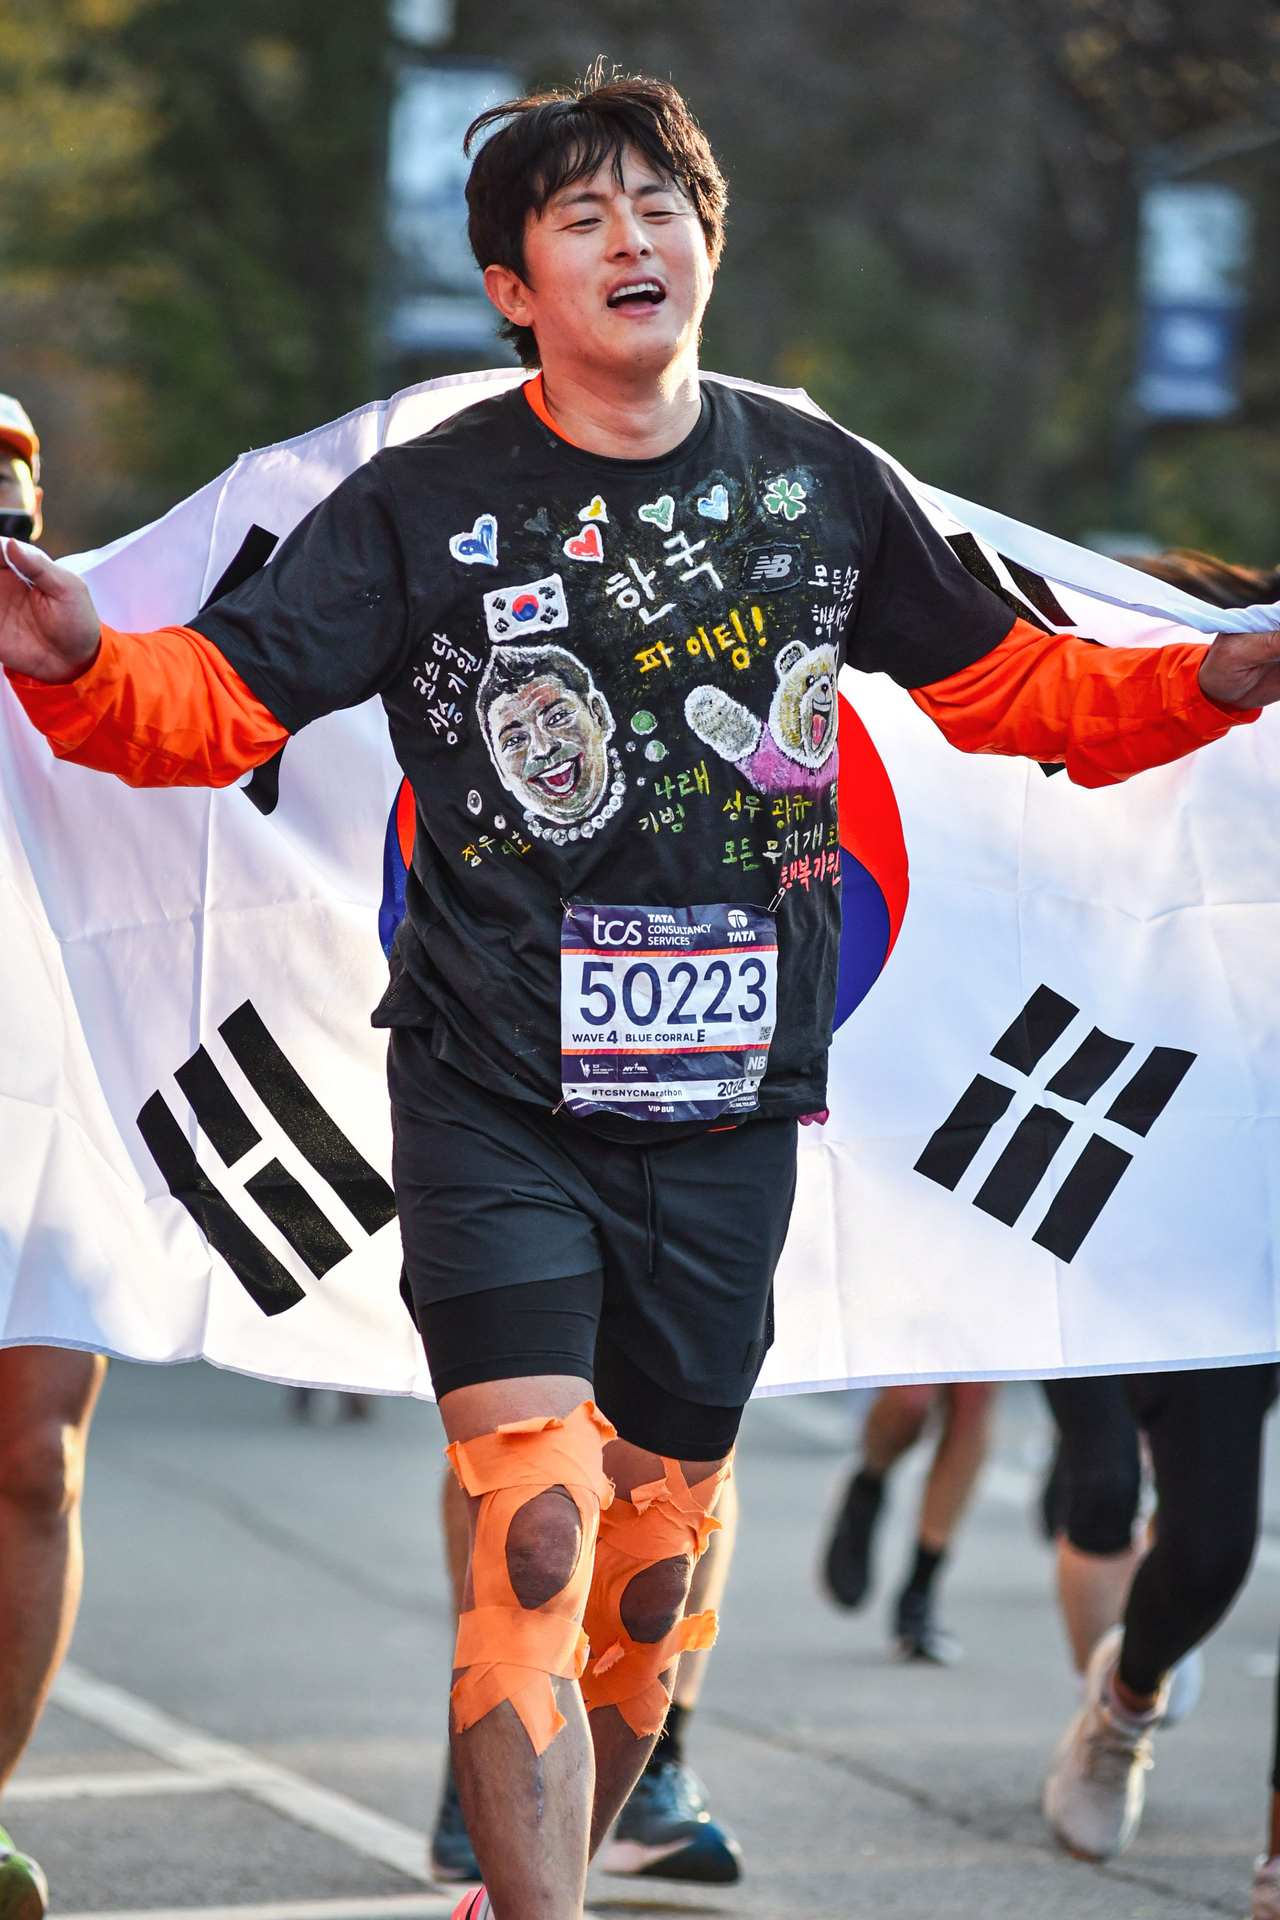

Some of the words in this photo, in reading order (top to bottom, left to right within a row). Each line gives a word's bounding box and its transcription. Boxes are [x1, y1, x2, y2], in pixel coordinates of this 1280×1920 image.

[605, 530, 724, 625] 한국
[750, 553, 793, 580] NB
[634, 606, 767, 673] 파이팅!
[412, 632, 458, 700] 코스닥
[427, 699, 463, 745] 상승
[448, 647, 483, 694] 기원
[654, 759, 710, 800] 나래
[638, 802, 686, 833] 기범
[722, 789, 764, 823] 성우
[772, 794, 814, 829] 광규
[722, 837, 760, 871] 모든
[762, 822, 824, 865] 무지개
[592, 914, 643, 946] tcs
[648, 914, 676, 924] TATA
[648, 924, 712, 935] CONSULTANCY
[648, 936, 691, 946] SERVICES
[727, 930, 756, 943] TATA
[579, 957, 768, 1027] 50223
[572, 1033, 605, 1043] WAVE
[606, 1030, 619, 1044] 4
[625, 1033, 652, 1043] BLUE
[654, 1032, 695, 1043] CORRAL
[696, 1029, 706, 1043] E
[747, 1055, 767, 1071] NB
[591, 1089, 683, 1098] #TCSNYCMarathon
[717, 1078, 747, 1097] 2024
[647, 1105, 660, 1113] VIP
[661, 1105, 675, 1113] BUS
